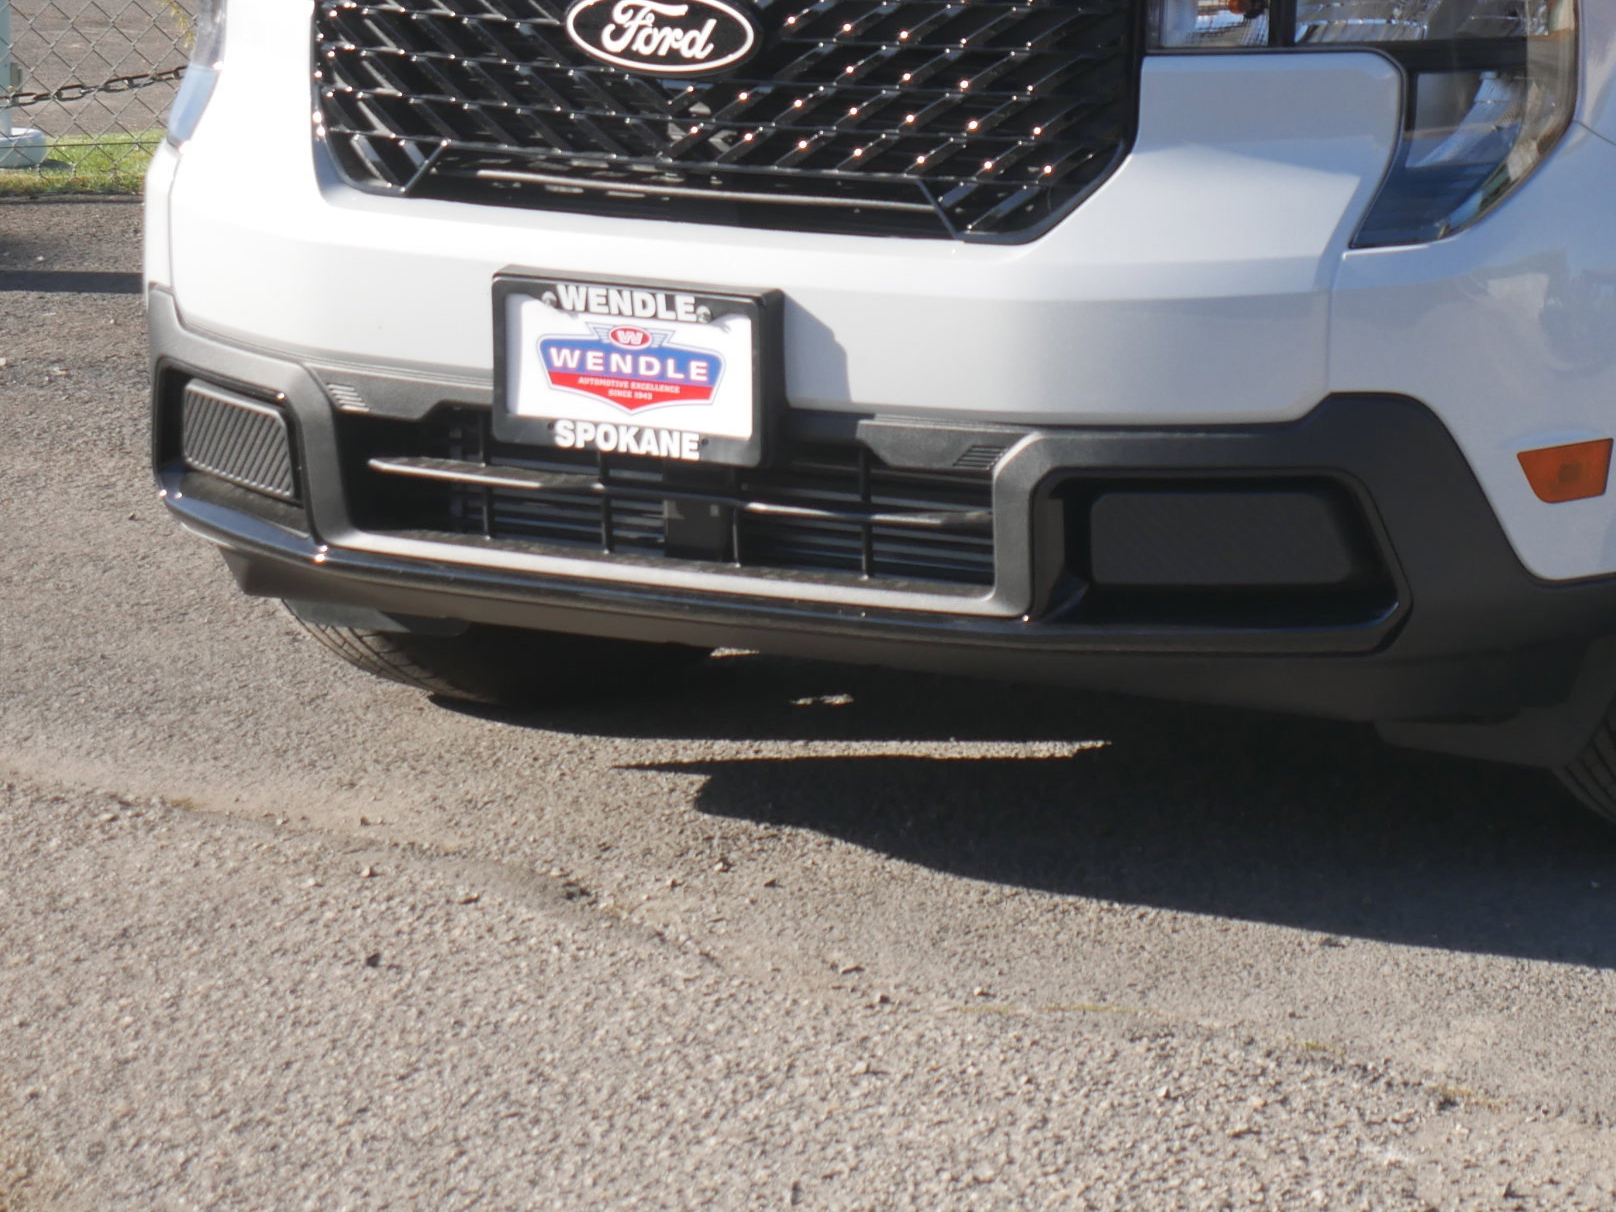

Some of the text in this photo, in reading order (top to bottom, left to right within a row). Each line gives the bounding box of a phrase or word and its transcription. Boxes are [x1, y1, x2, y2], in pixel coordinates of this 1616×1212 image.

[555, 284, 698, 322] WENDLE
[550, 347, 709, 382] WENDLE
[578, 376, 681, 394] AUTOMOTIVE EXCELLENCE
[607, 388, 633, 398] SINCE
[555, 419, 701, 460] SPOKANE
